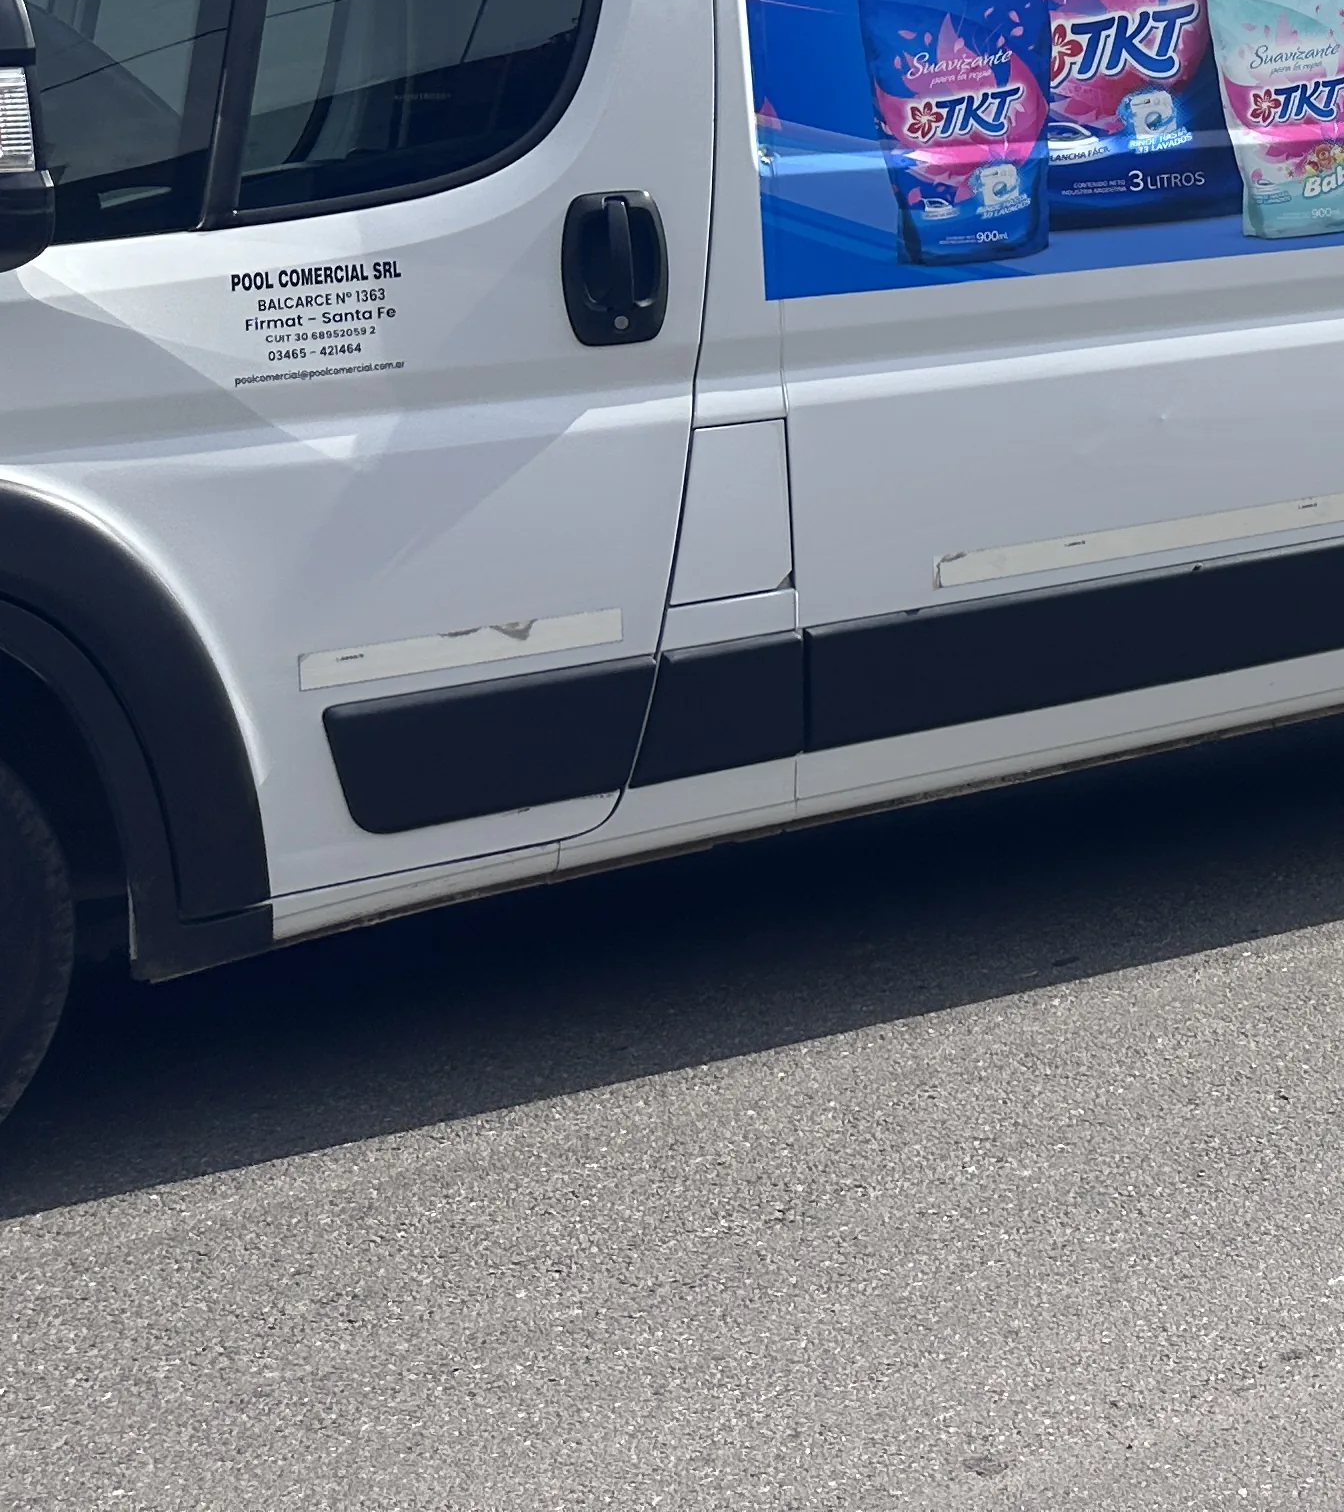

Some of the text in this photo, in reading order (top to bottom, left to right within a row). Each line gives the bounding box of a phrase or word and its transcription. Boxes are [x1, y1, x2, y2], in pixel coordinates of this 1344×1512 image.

[1071, 3, 1195, 75] TKT
[907, 49, 1013, 79] Suavizante
[1250, 44, 1340, 69] Suavizante
[935, 87, 1021, 135] TKT
[1050, 149, 1086, 162] LANCHA
[1128, 170, 1206, 191] 3 LITROS
[231, 261, 401, 291] POOL COMERCIAL SRL
[258, 293, 332, 311] BALCARCE
[356, 288, 386, 303] 1363
[245, 314, 303, 331] Firmat
[322, 309, 372, 324] Santa
[377, 306, 396, 319] Fe
[265, 334, 291, 343] CUIT
[294, 332, 309, 342] 30
[369, 325, 376, 335] 2
[268, 348, 307, 361] 03465
[320, 342, 362, 356] 421464
[235, 360, 405, 388] poolcomercial@poolcomercial.com.ar
